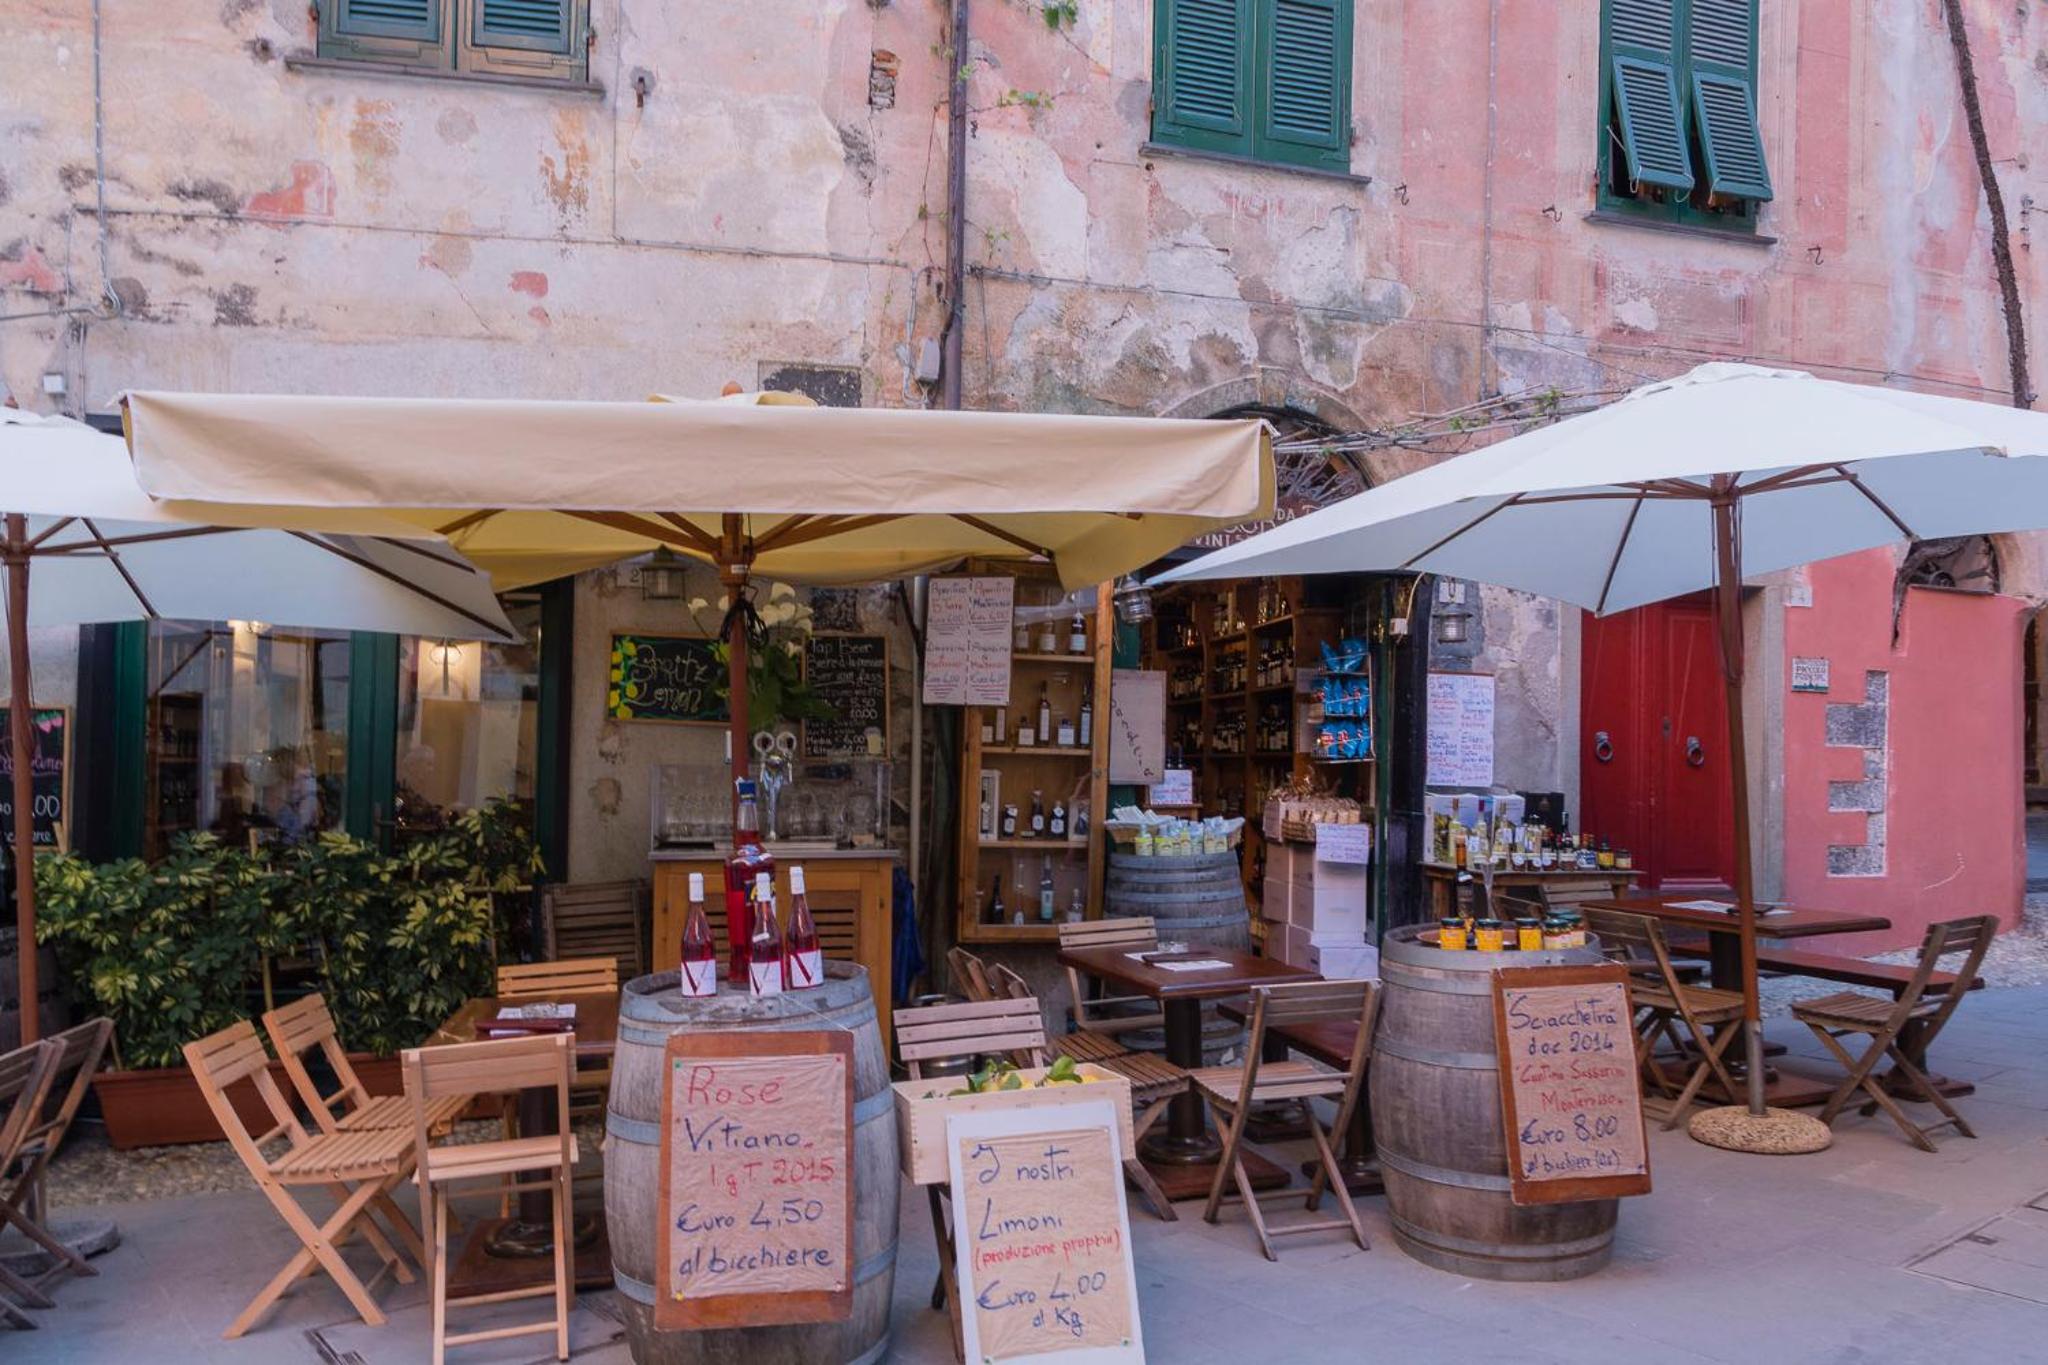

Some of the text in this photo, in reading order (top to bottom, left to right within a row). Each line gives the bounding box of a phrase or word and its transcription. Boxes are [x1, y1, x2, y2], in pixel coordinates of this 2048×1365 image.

[1528, 1031, 1614, 1055] doc 2014
[772, 1157, 836, 1185] 2015
[1017, 1144, 1074, 1181] nostri
[979, 1197, 1062, 1240] Limoni
[708, 1244, 834, 1273] bicchiere
